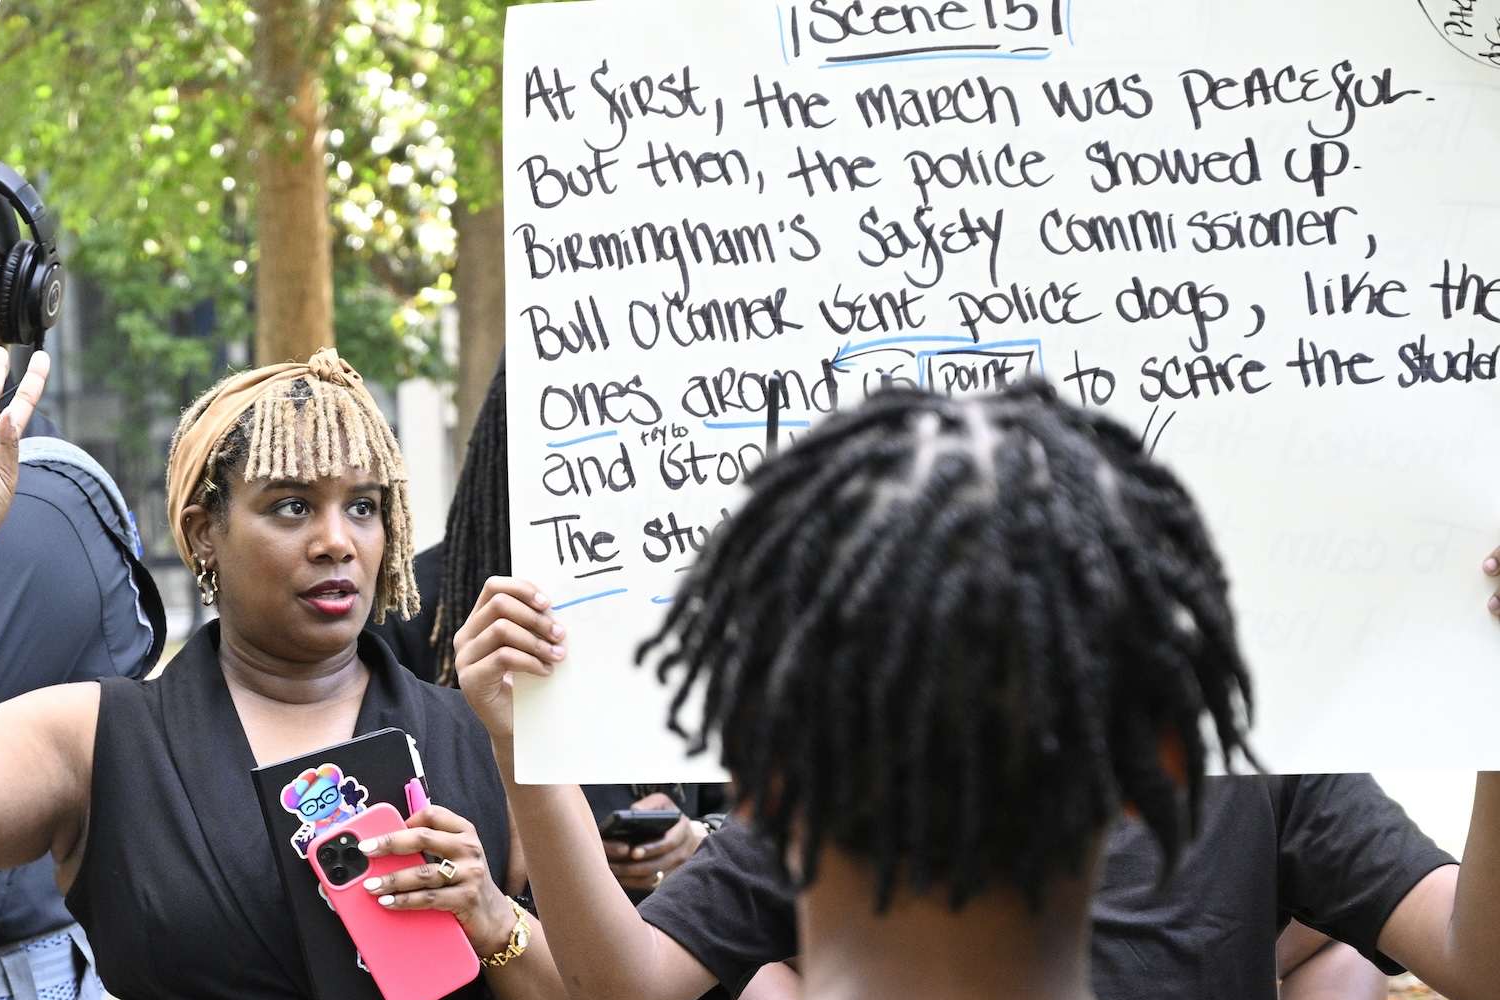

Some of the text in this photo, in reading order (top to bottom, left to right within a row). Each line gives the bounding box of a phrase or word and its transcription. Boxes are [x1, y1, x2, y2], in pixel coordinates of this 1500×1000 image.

[809, 0, 977, 43] Scene
[526, 67, 576, 121] At
[745, 75, 836, 129] the
[1043, 74, 1153, 122] was
[518, 150, 619, 209] But
[637, 141, 765, 194] then,
[788, 147, 882, 197] the
[904, 143, 1055, 206] police
[520, 295, 610, 361] Bull
[949, 281, 1102, 344] police
[1116, 277, 1266, 352] dogs,
[1304, 271, 1411, 318] like
[1429, 259, 1500, 323] the
[540, 374, 662, 430] ones
[1064, 350, 1116, 407] to
[1286, 337, 1385, 387] the
[542, 442, 637, 497] and
[530, 514, 620, 566] The
